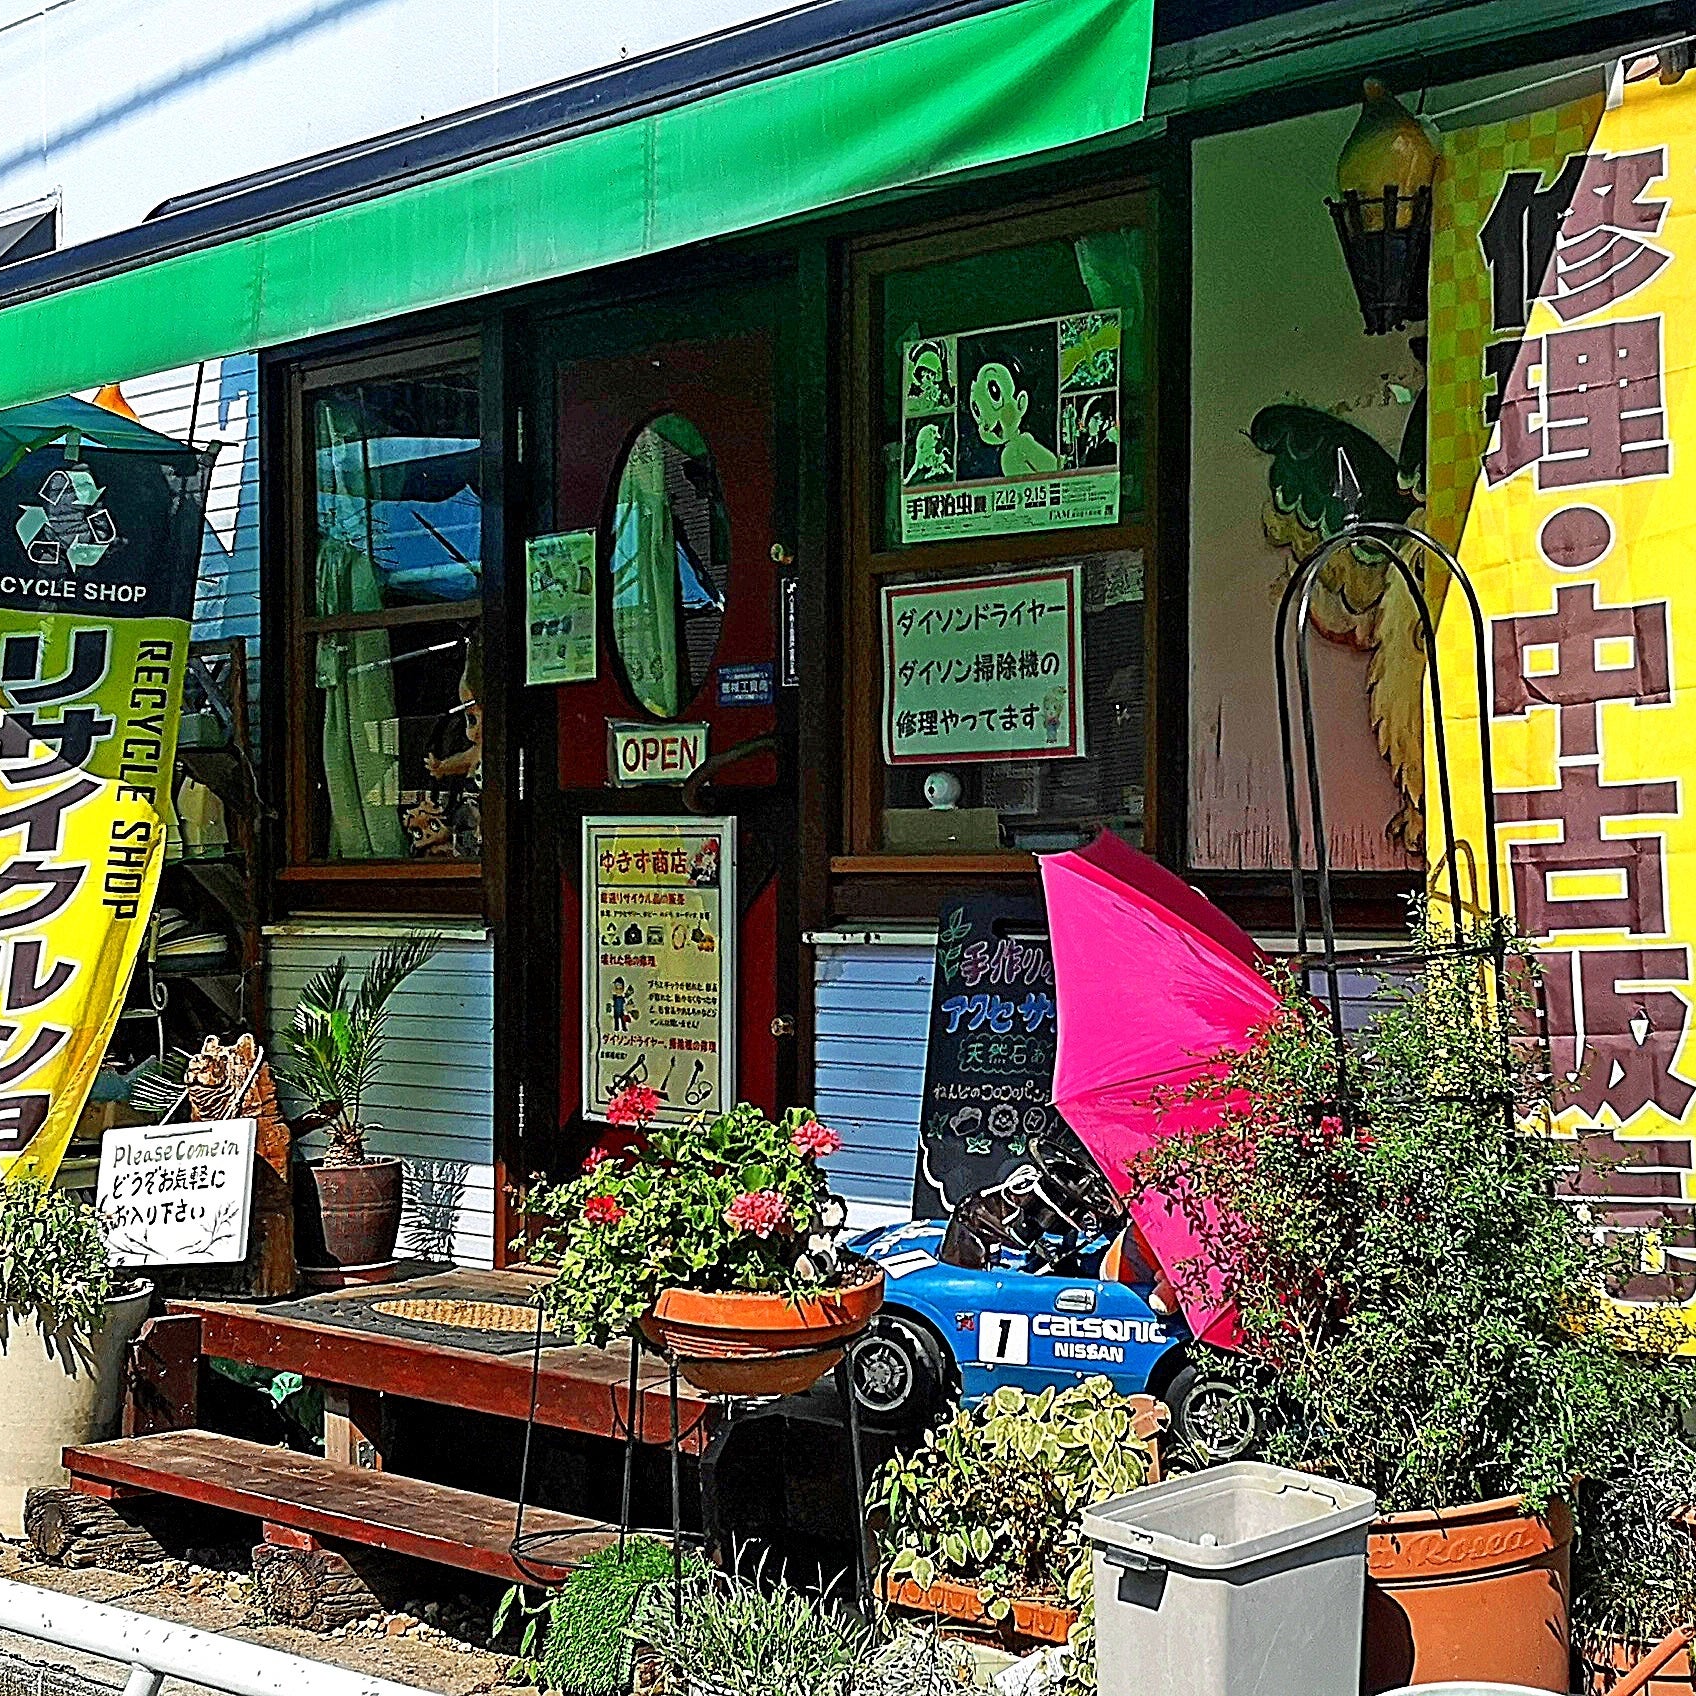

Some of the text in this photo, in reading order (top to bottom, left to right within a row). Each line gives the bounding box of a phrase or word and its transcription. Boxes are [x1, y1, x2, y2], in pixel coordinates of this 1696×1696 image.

[84, 583, 147, 602] SHOP
[897, 598, 1066, 637] ダイソンドライヤー
[898, 649, 1060, 687] ダイソン掃除機の
[896, 702, 1040, 739] 修理やってます
[622, 735, 699, 774] OPEN
[102, 640, 173, 920] RECYCLE SHOP
[112, 1165, 226, 1200] どうぞお気軽に
[106, 1198, 206, 1230] お入り下さい
[996, 1318, 1011, 1358] 1
[1054, 1342, 1124, 1363] NISSAN
